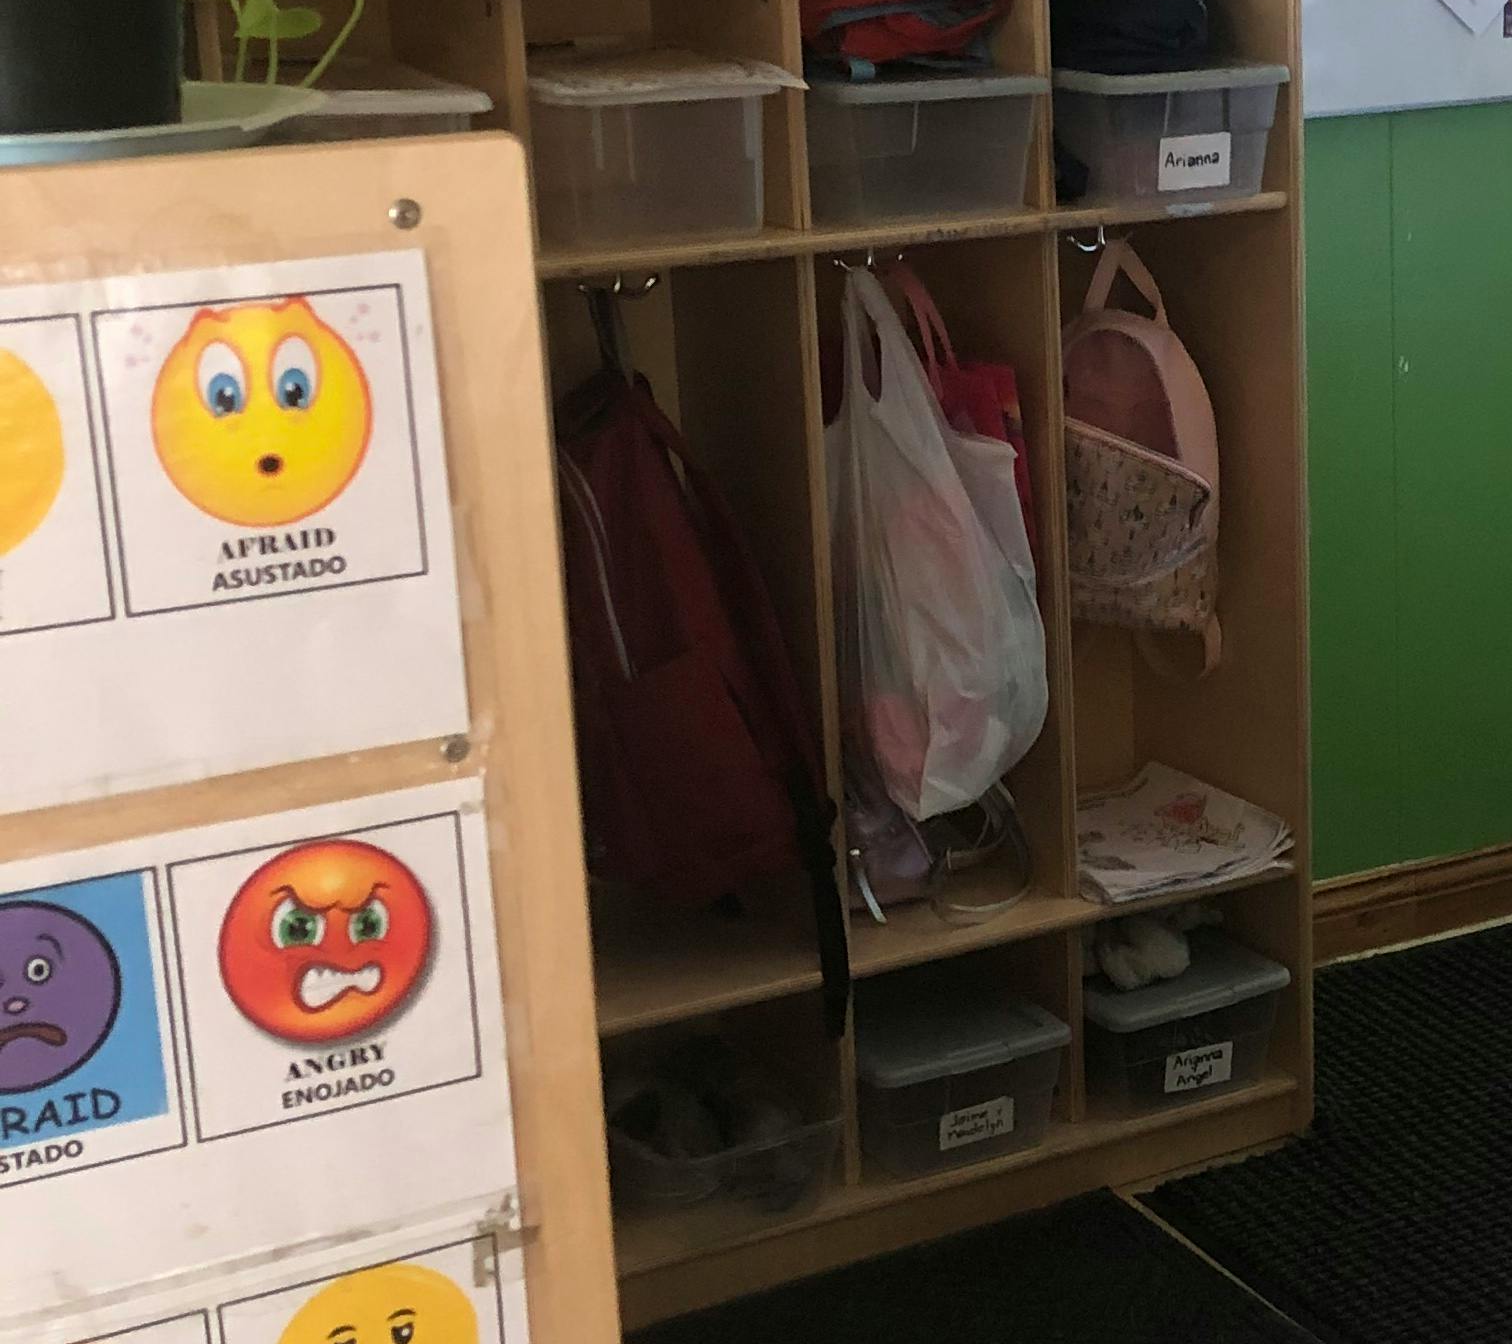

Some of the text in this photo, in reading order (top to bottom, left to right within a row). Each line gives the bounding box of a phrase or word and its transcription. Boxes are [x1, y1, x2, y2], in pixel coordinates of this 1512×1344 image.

[1163, 149, 1221, 169] Arianna
[216, 525, 338, 565] AFRAID
[211, 555, 348, 593] ASUSTADO
[283, 1040, 387, 1083] ANGRY
[1175, 1066, 1214, 1088] Angel
[281, 1068, 396, 1110] ENOJADO
